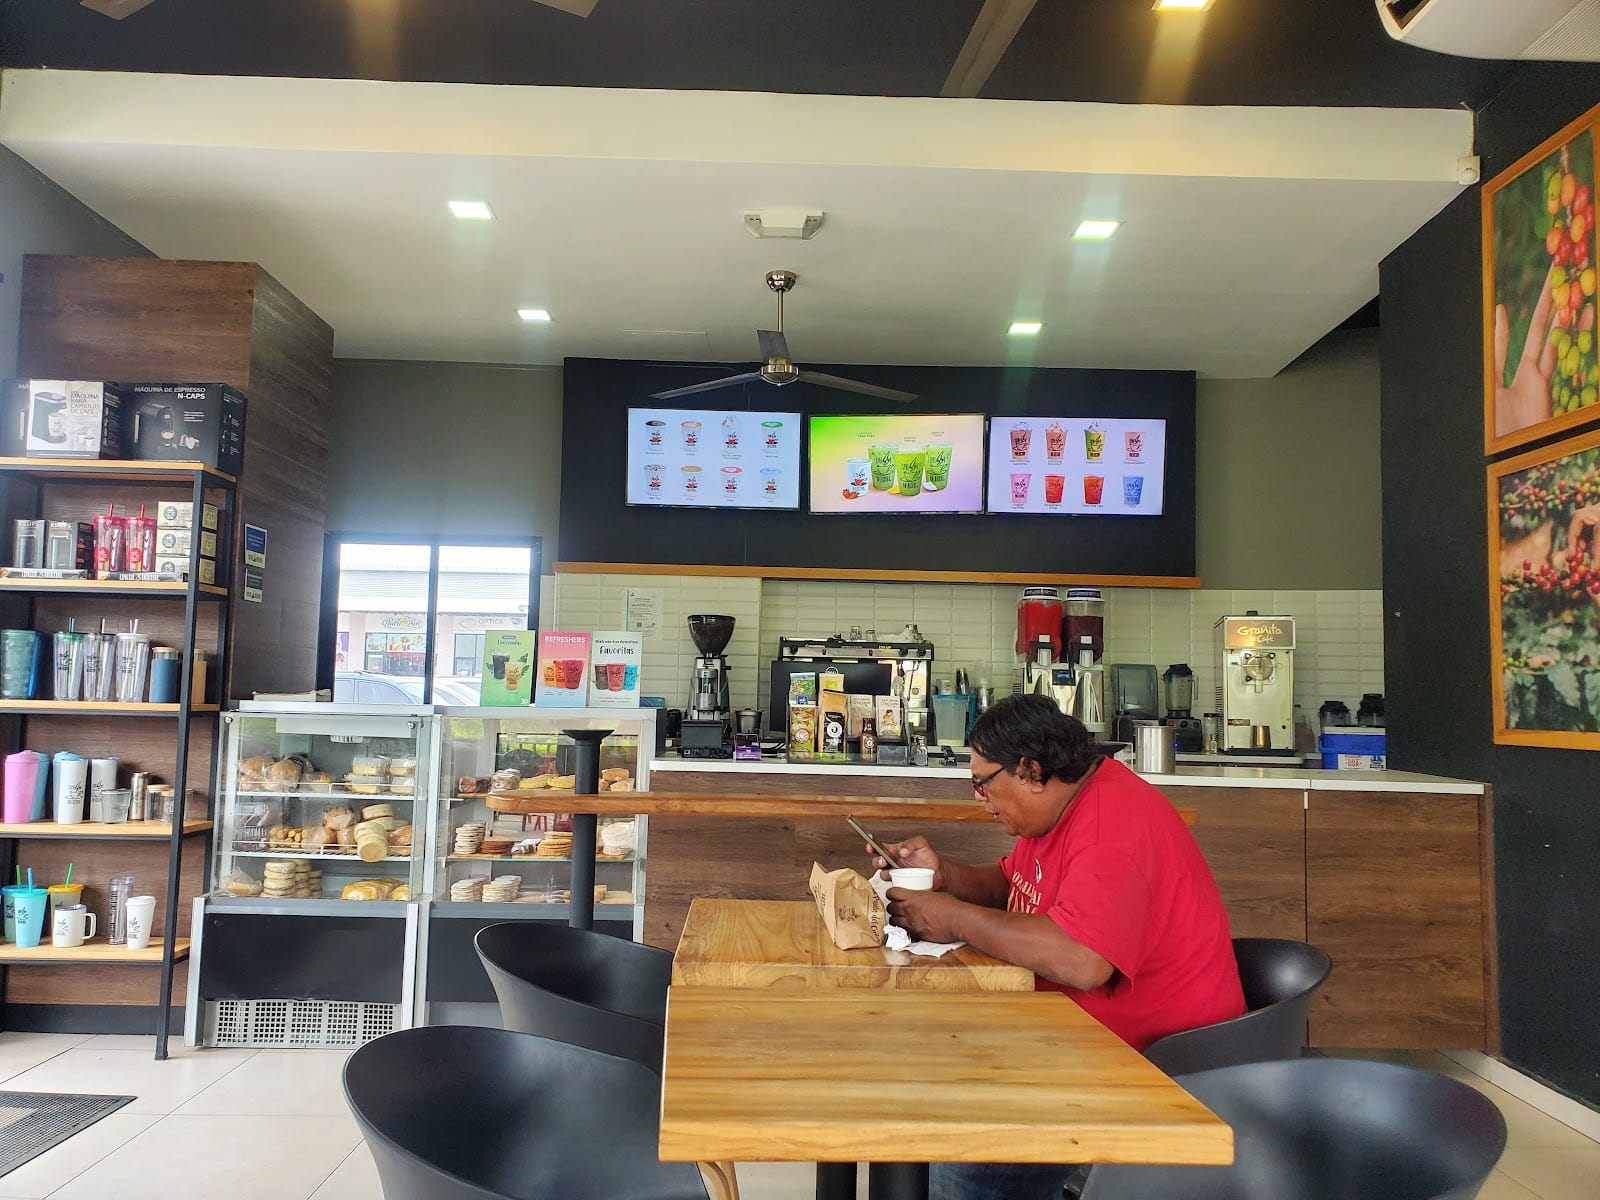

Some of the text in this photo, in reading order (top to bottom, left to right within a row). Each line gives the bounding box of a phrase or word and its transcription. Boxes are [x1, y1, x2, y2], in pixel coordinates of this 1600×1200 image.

[134, 385, 163, 393] MÁQUINA
[544, 635, 586, 643] REFRESHERS
[599, 645, 635, 655] Favoritas
